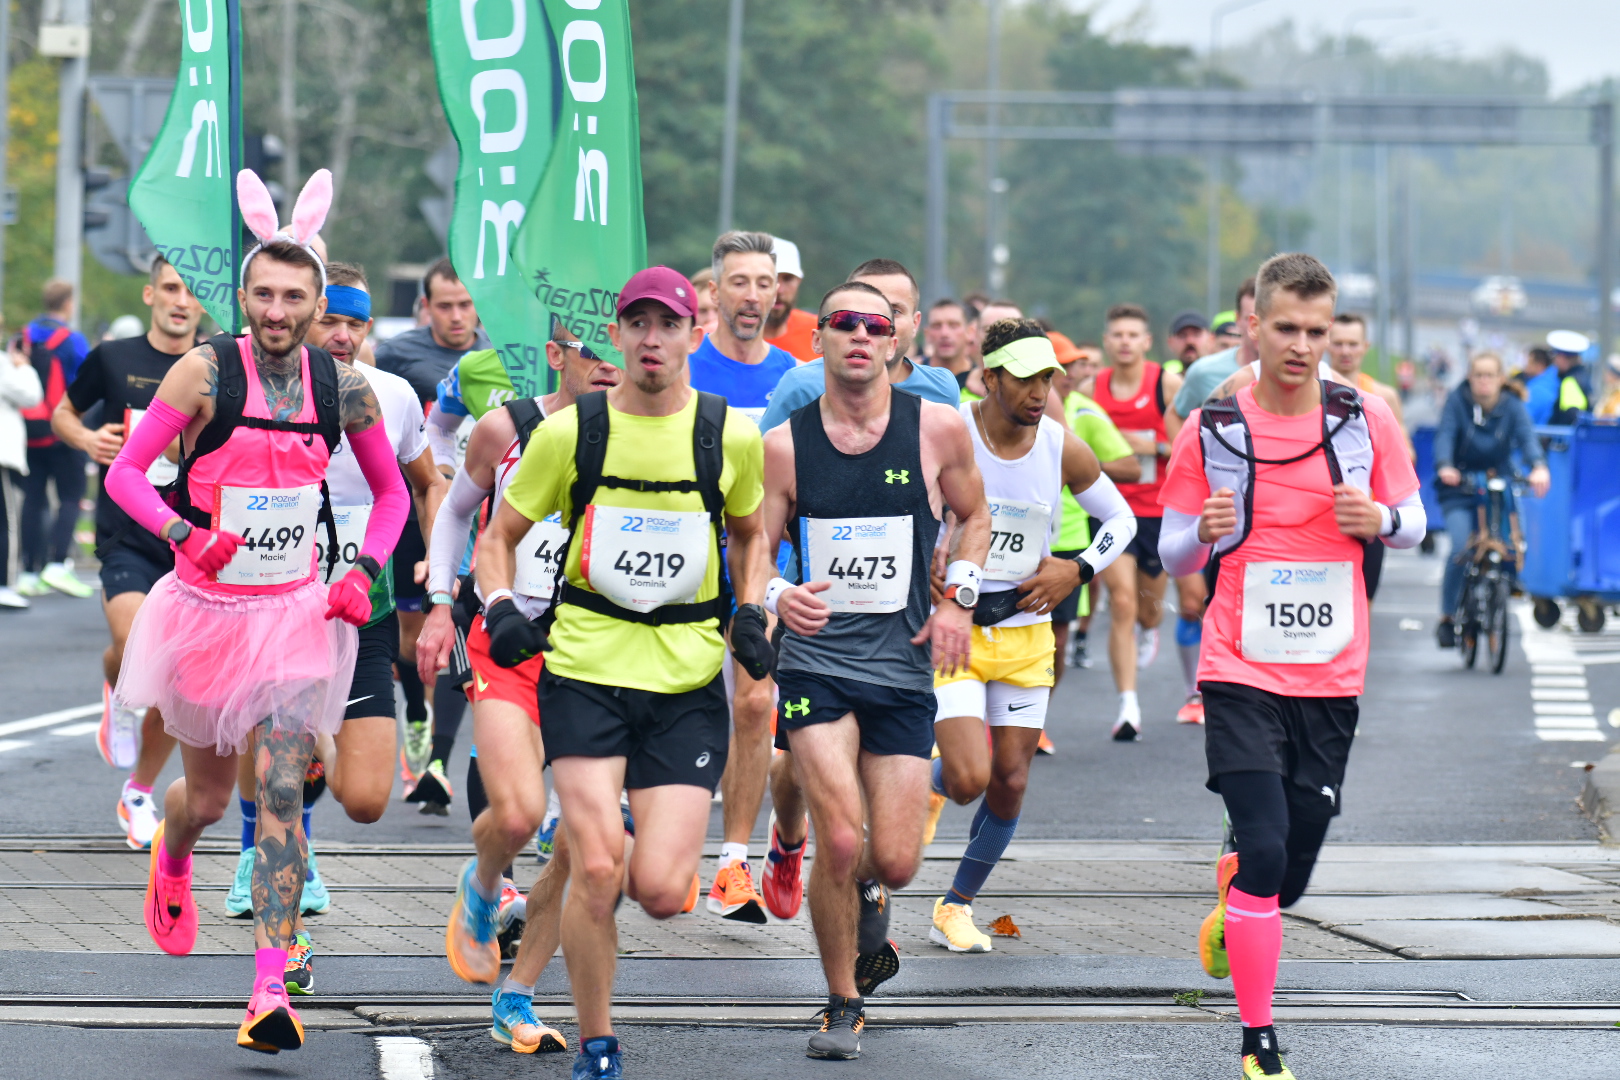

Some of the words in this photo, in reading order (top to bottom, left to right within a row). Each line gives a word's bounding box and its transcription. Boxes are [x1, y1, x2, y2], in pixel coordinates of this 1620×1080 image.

[247, 495, 269, 510] 22
[271, 501, 299, 509] maraton
[988, 503, 1000, 516] 2
[620, 515, 644, 533] 22
[646, 524, 680, 533] maraton
[238, 525, 305, 551] 4499
[831, 525, 852, 541] 22
[855, 530, 886, 538] maraton
[989, 530, 1025, 553] 778
[260, 553, 287, 561] Maciej
[990, 552, 1005, 561] Siraj
[544, 567, 558, 575] Ark
[614, 550, 685, 579] 4219
[828, 555, 897, 580] 4473
[630, 578, 667, 588] Dominik
[1270, 569, 1293, 585] 22
[848, 582, 878, 592] Mikołaj
[1265, 602, 1333, 628] 1508
[1283, 630, 1316, 640] Szymon
